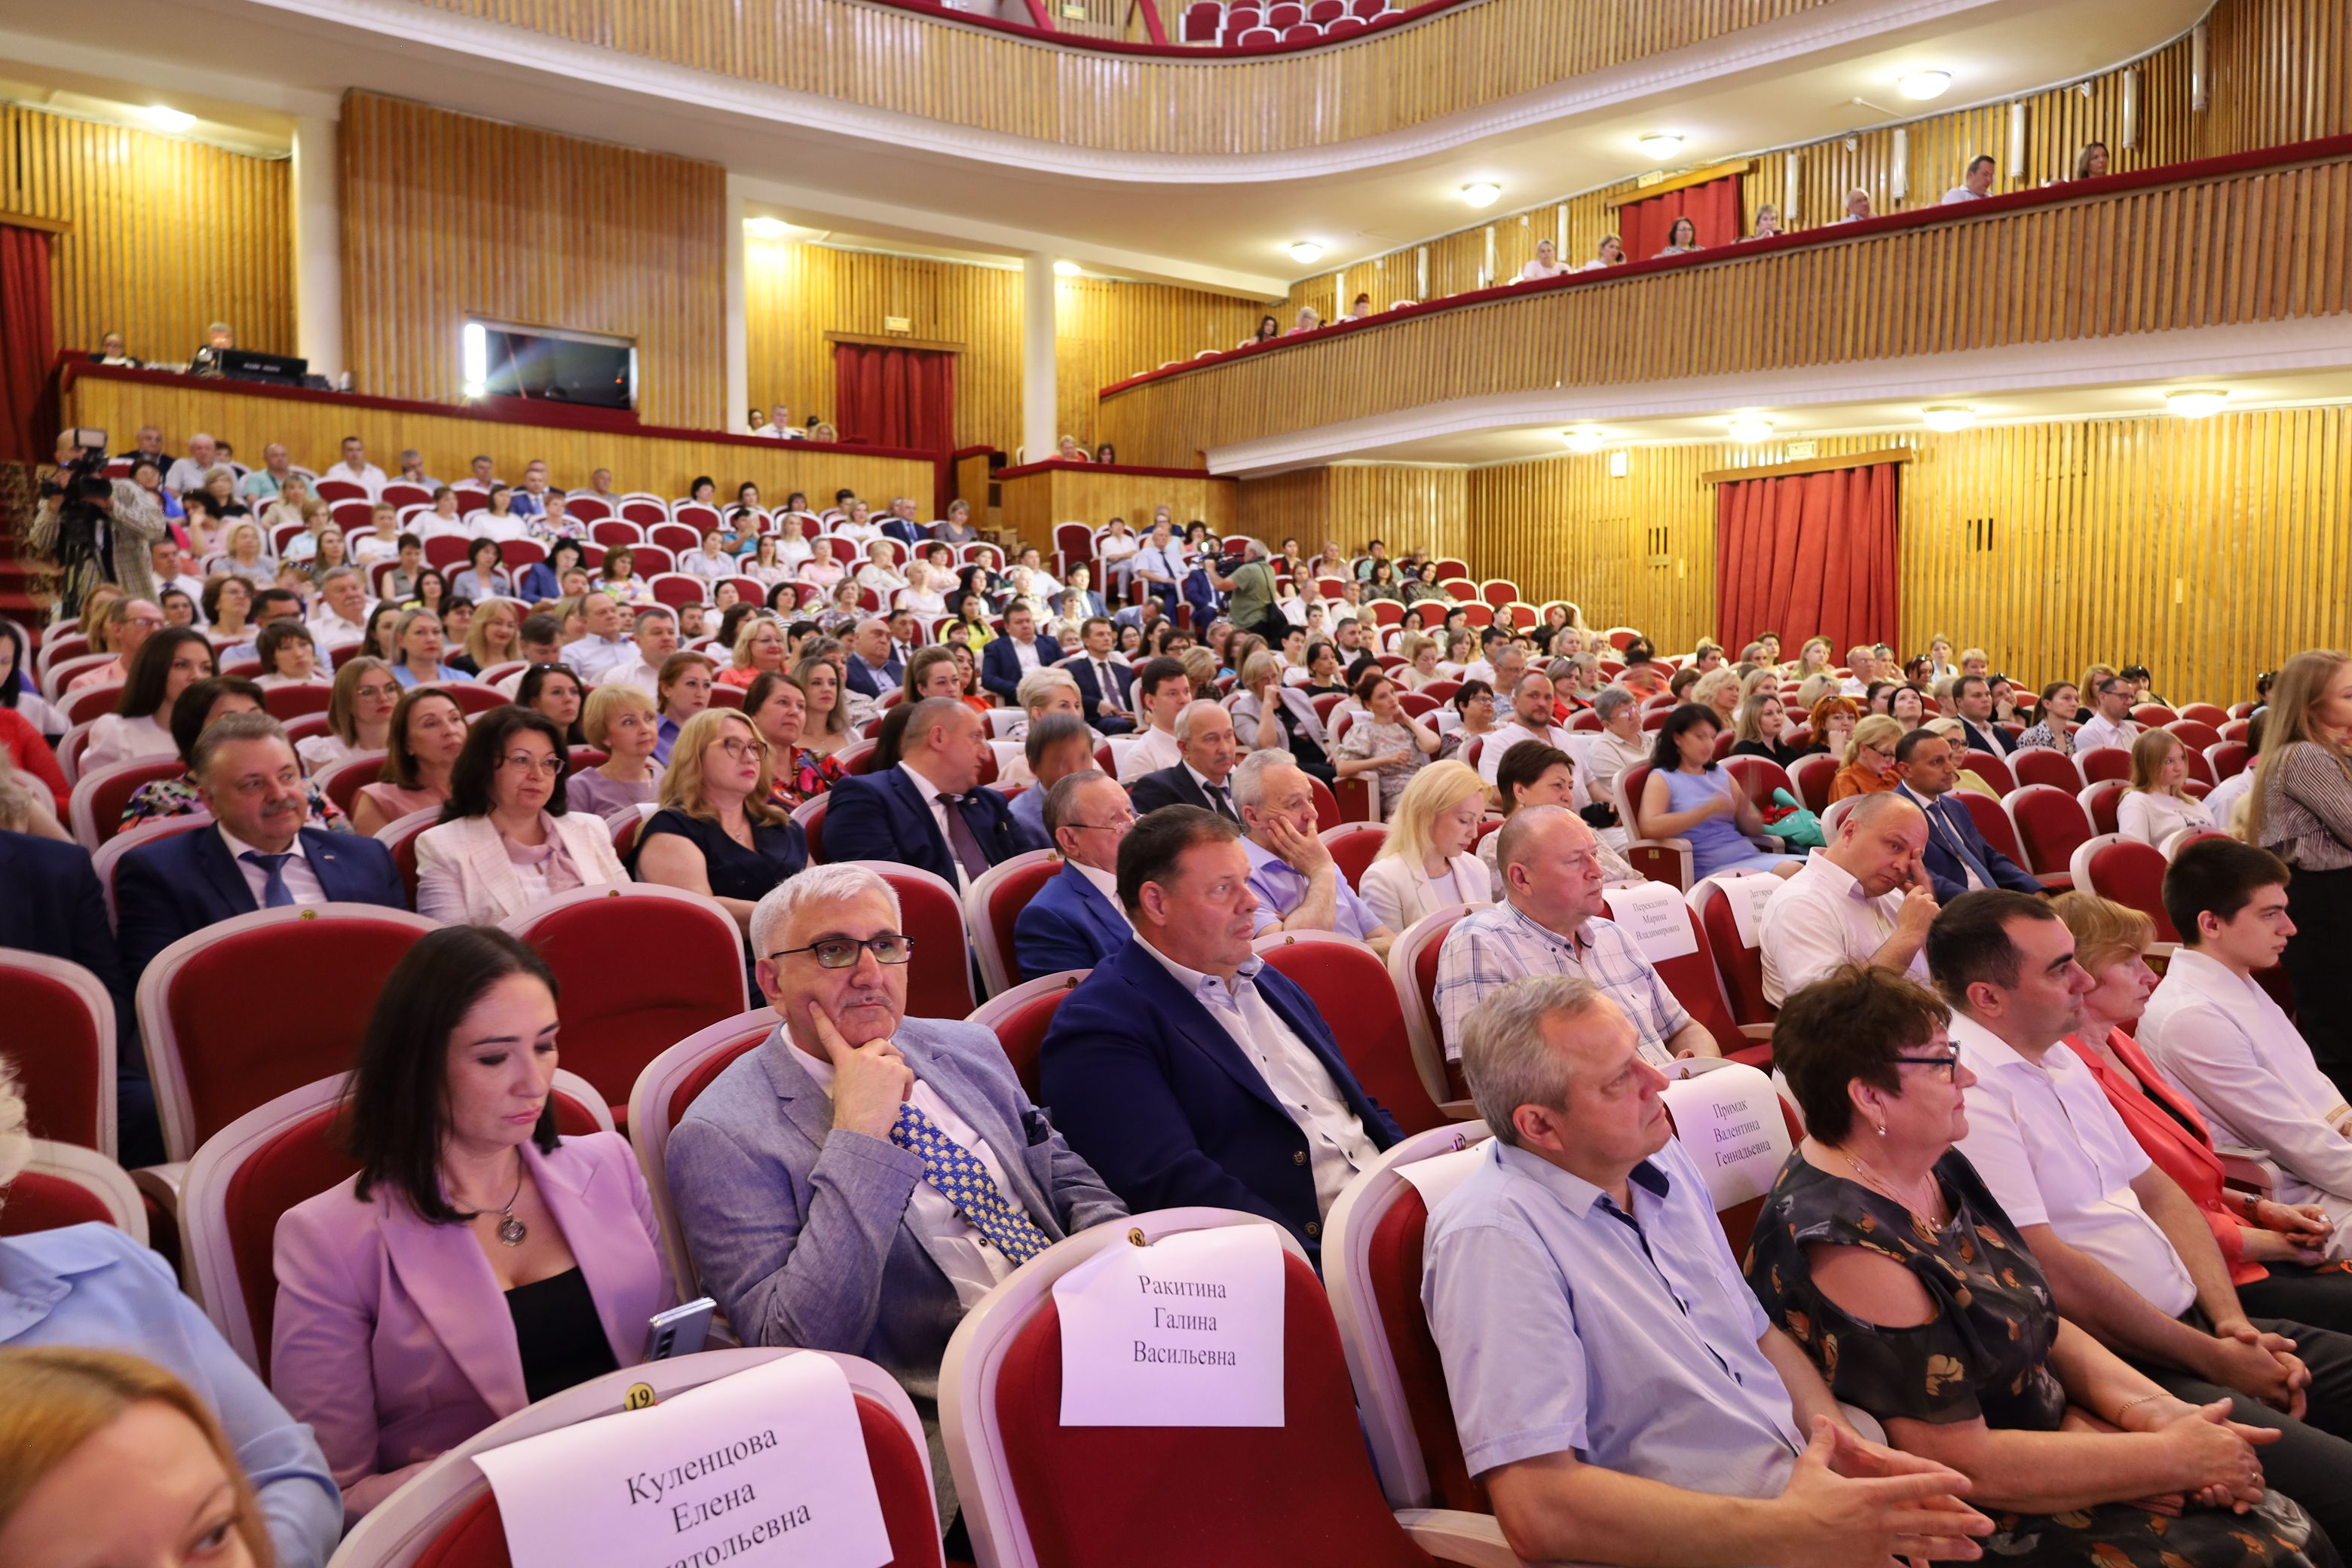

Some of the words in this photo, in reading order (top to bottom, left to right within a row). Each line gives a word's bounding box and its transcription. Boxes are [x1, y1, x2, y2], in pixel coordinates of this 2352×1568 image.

[1642, 913, 1668, 925] Марина
[1635, 924, 1680, 941] Владимировна
[1712, 1099, 1748, 1121] Примак
[1713, 1119, 1760, 1143] Валентина
[1715, 1139, 1772, 1167] Геннадьевна
[1138, 1275, 1227, 1299] Ракитина
[1154, 1306, 1217, 1331] Галина
[1133, 1340, 1236, 1366] Васильевна
[629, 1389, 650, 1410] 19
[625, 1429, 779, 1506] Куленцова
[670, 1482, 756, 1534] Елена
